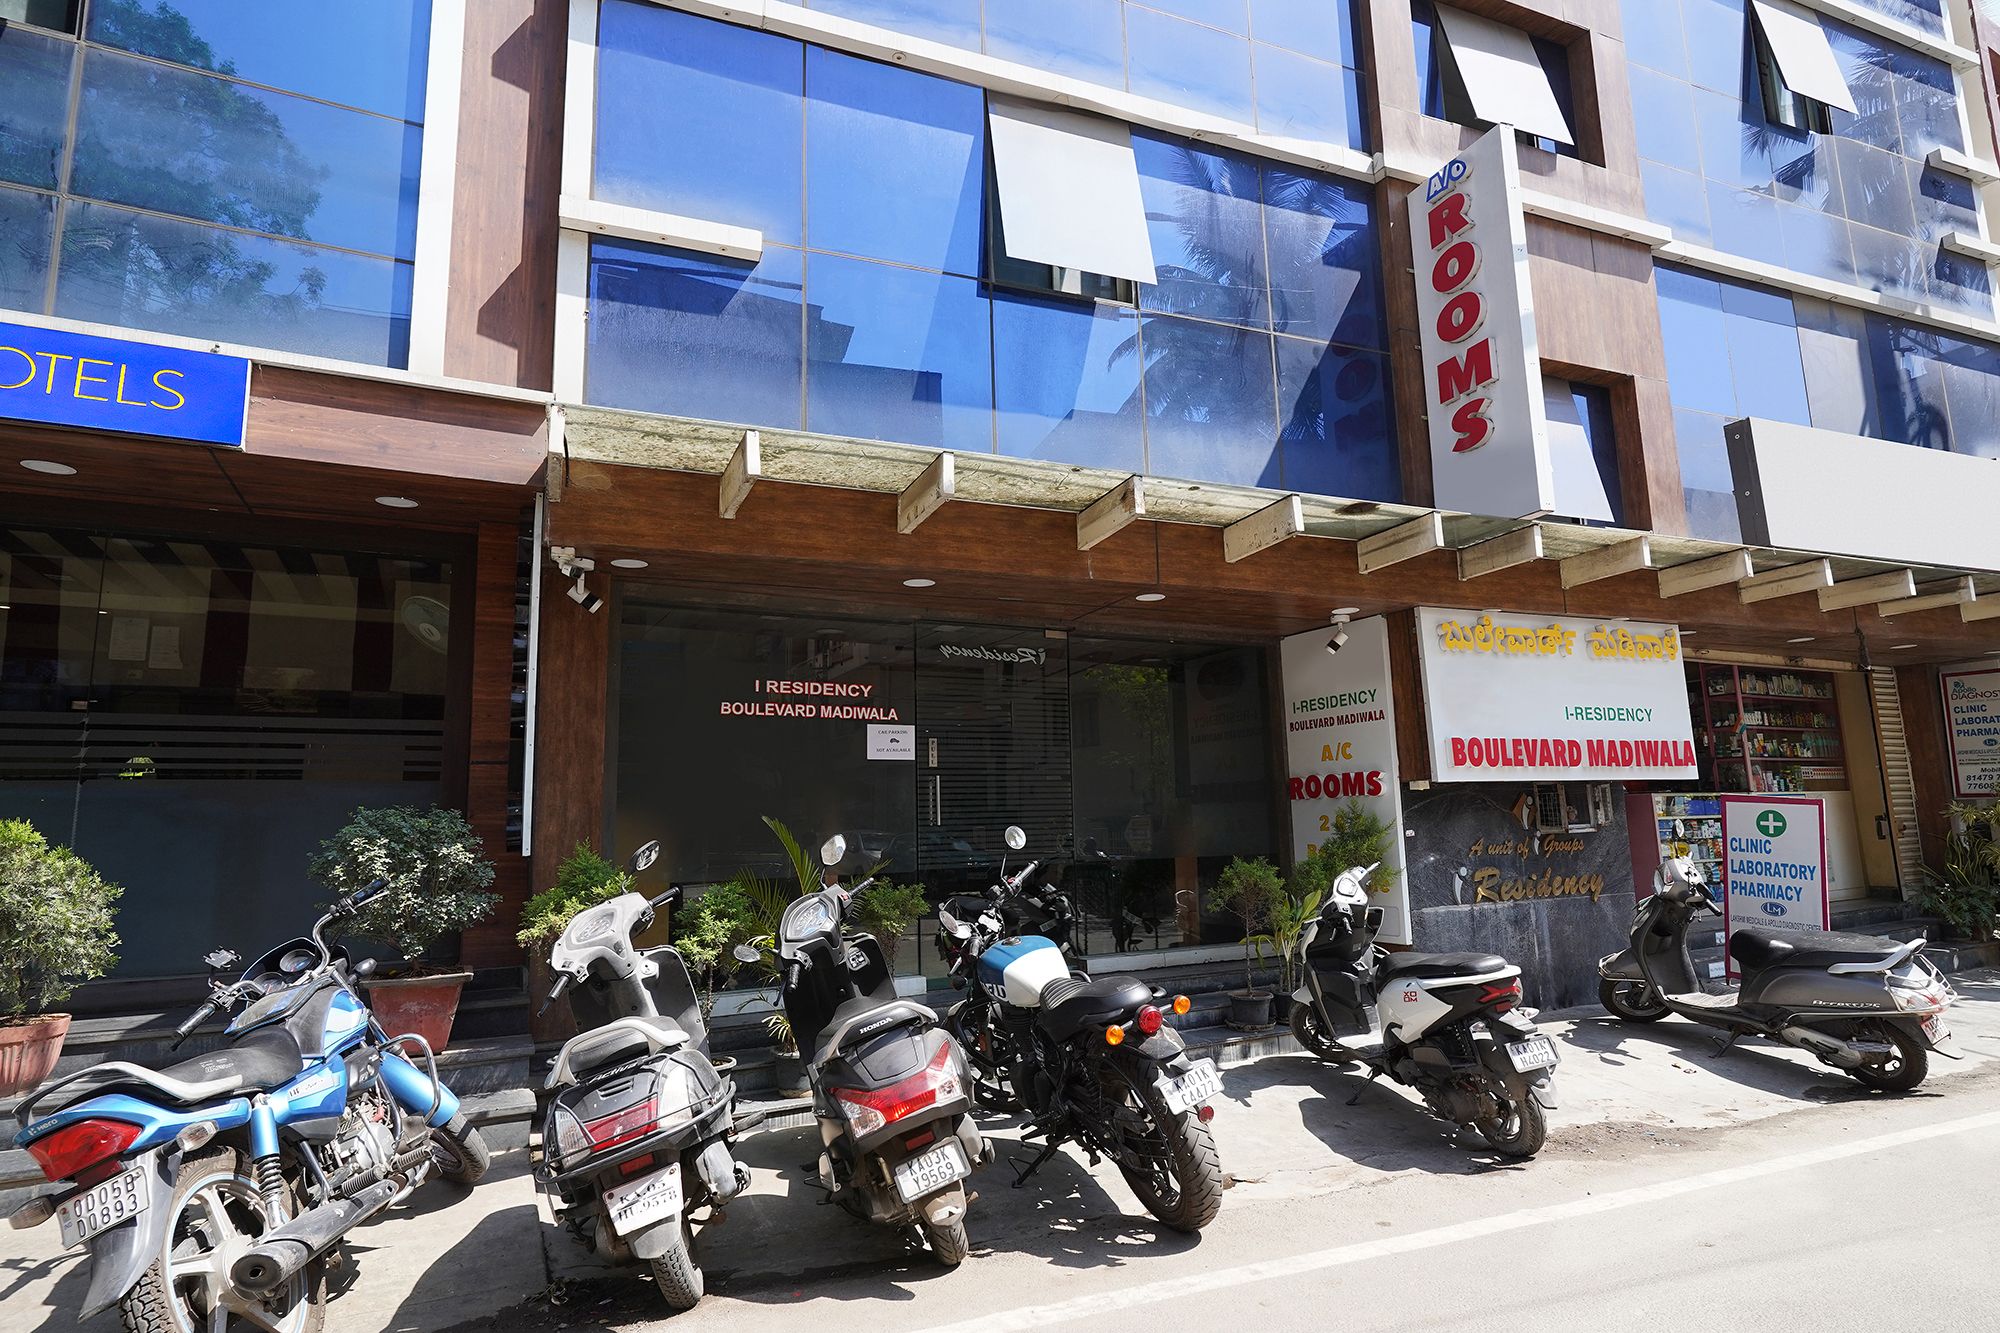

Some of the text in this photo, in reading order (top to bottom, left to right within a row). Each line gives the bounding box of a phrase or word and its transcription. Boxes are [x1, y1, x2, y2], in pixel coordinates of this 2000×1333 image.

[1428, 192, 1494, 453] ROOMS
[0, 346, 186, 410] OTELS
[765, 680, 873, 698] RESIDENCY
[720, 701, 899, 721] BOULEVARD MADIWALA
[1292, 689, 1377, 714] I-RESIDENCY
[1953, 704, 1988, 714] CLINIC
[1289, 709, 1386, 732] BOULEVARD MADIWALA
[1565, 706, 1652, 722] I-RESIDENCY
[1956, 727, 2000, 737] PHARMA
[1321, 741, 1353, 762] A/C
[1451, 736, 1697, 768] BOULEVARD MADIWALA
[1289, 770, 1384, 800] ROOMS
[1468, 836, 1485, 857] A
[1487, 839, 1514, 855] unit
[1517, 836, 1530, 862] of
[1543, 834, 1585, 858] Groups
[1729, 837, 1772, 855] CLINIC
[1730, 859, 1817, 881] LABORATORY
[1473, 866, 1605, 904] Residency
[1731, 880, 1803, 902] PHARMACY
[859, 1017, 893, 1034] HONDA
[906, 1147, 950, 1176] KA03K
[913, 1161, 955, 1191] Y9569
[77, 1193, 138, 1238] D0893
